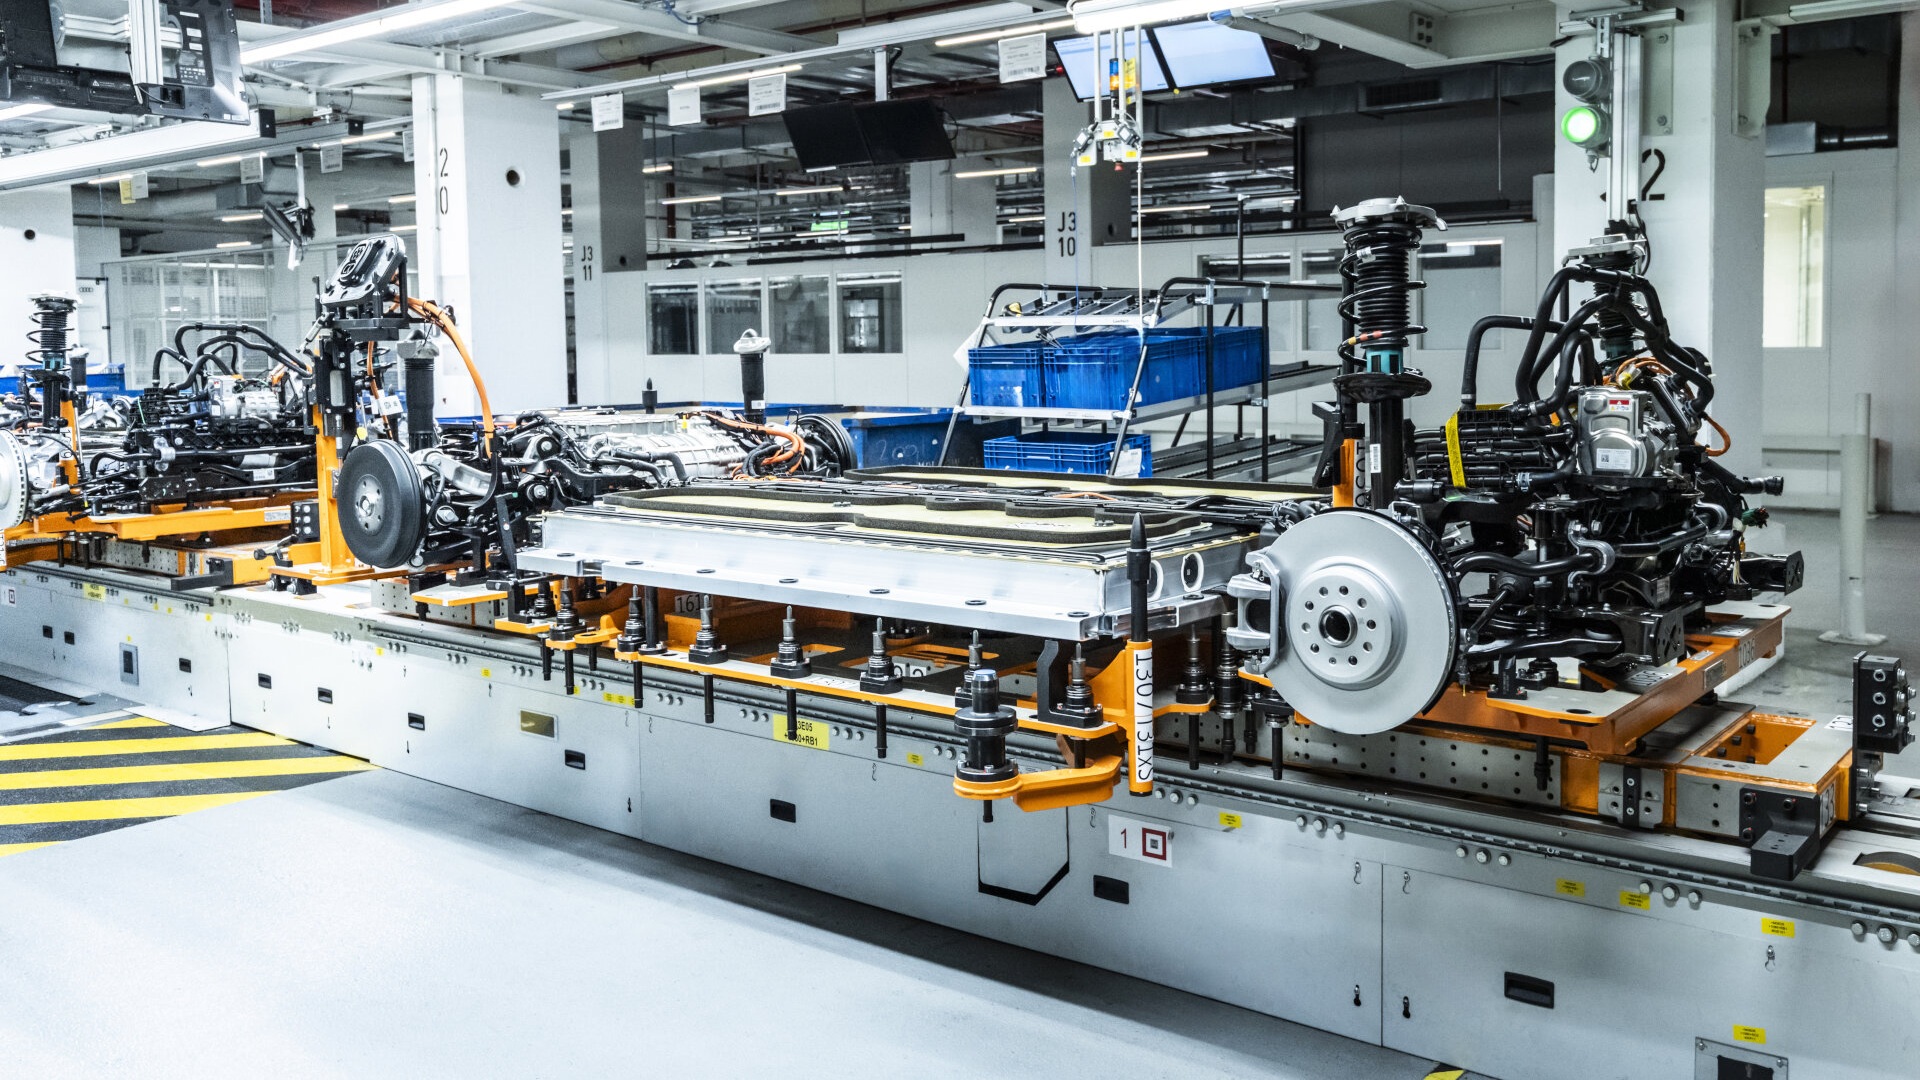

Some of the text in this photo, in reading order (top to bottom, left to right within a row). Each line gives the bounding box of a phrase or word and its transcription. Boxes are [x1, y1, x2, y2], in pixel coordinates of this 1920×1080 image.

[1641, 148, 1666, 202] 2
[1057, 211, 1076, 232] J3
[581, 245, 593, 262] J3
[1058, 236, 1076, 258] 10
[583, 264, 592, 281] 11
[784, 731, 818, 747] +0+RB1
[1120, 827, 1127, 849] 1
